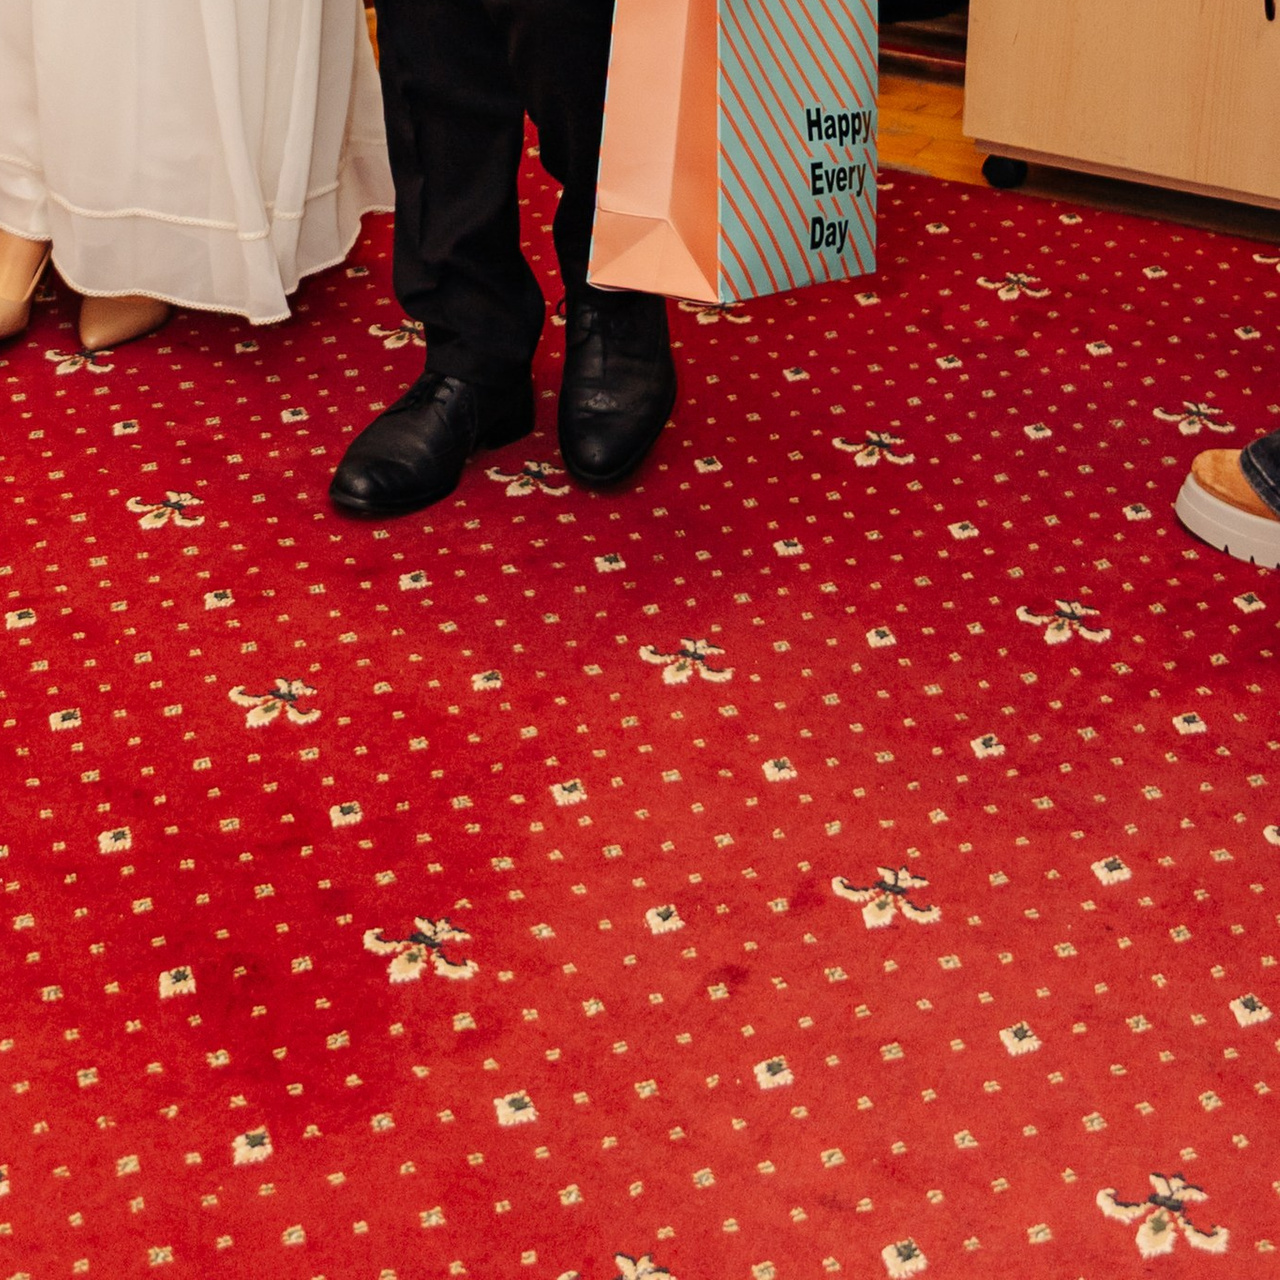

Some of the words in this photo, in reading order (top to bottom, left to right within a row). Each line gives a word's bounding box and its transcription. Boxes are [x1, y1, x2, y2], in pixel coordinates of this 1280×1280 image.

[806, 107, 872, 147] Happy
[810, 161, 866, 198] Every
[810, 215, 849, 254] Day
